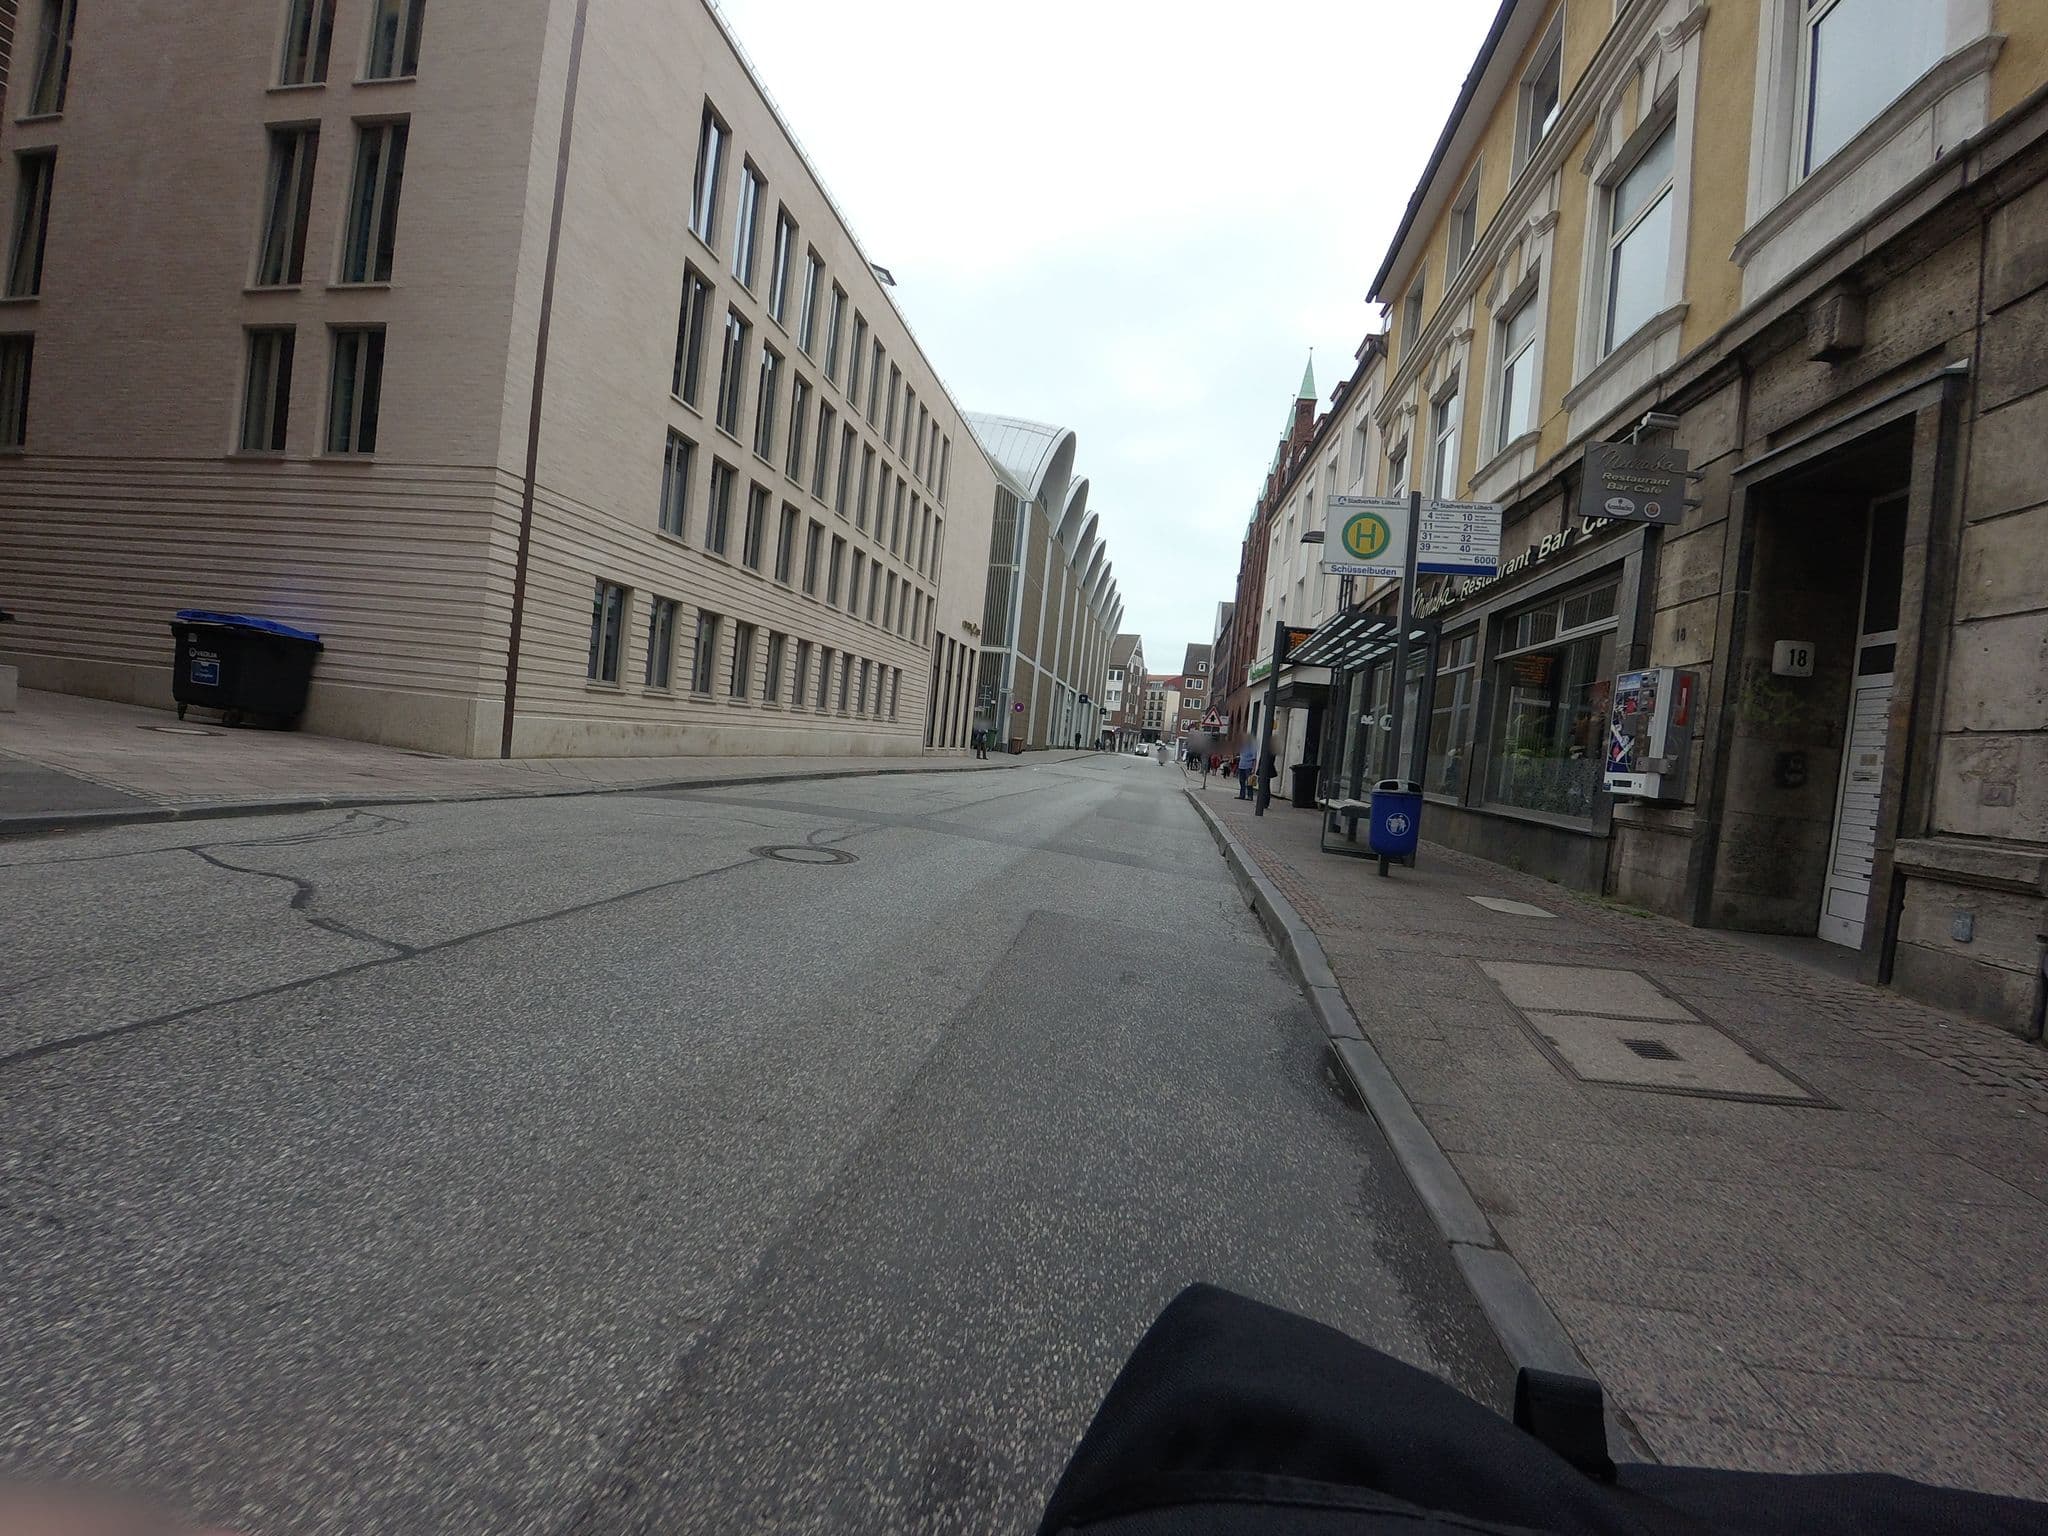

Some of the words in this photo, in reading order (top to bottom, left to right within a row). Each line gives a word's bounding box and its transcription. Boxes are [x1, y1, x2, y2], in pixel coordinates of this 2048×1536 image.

[1602, 472, 1671, 486] Restaurant
[1606, 482, 1630, 492] Bar
[1463, 513, 1473, 522] 10
[1463, 524, 1473, 532] 21
[1356, 522, 1377, 549] H
[1422, 532, 1432, 540] 31
[1460, 534, 1472, 543] 32
[1420, 543, 1431, 551] 39
[1538, 527, 1572, 560] Bar
[1459, 545, 1471, 553] 40
[1474, 556, 1497, 565] 6000
[1331, 564, 1397, 576] Schüsselbuden
[1789, 648, 1808, 667] 18
